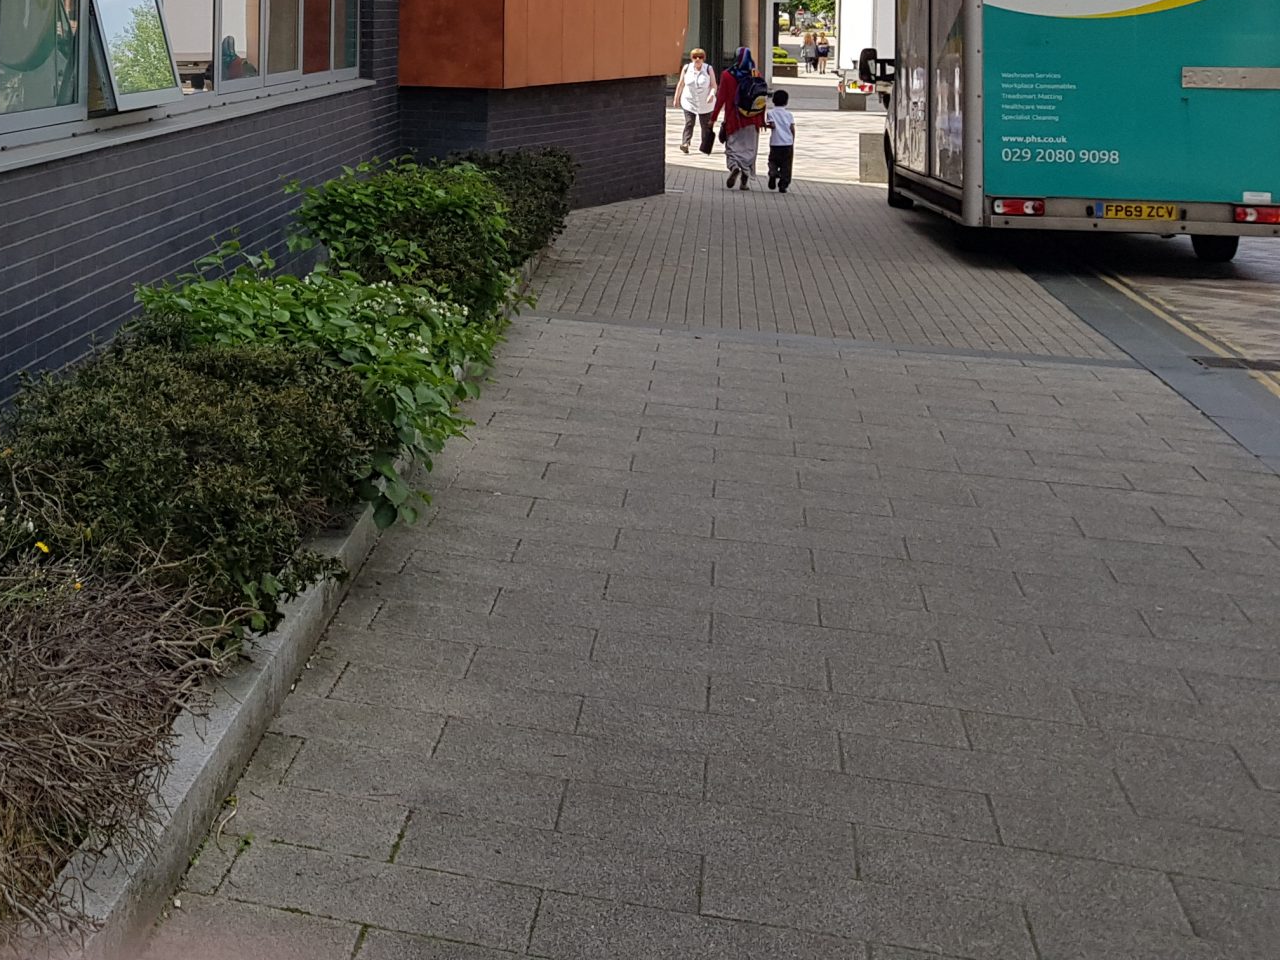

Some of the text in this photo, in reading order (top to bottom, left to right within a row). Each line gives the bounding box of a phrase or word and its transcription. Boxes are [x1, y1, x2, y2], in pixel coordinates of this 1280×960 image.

[1001, 135, 1067, 143] www.phs.co.uk
[1001, 148, 1120, 164] 029 2080 9098
[1106, 205, 1174, 218] FP69 ZCV
